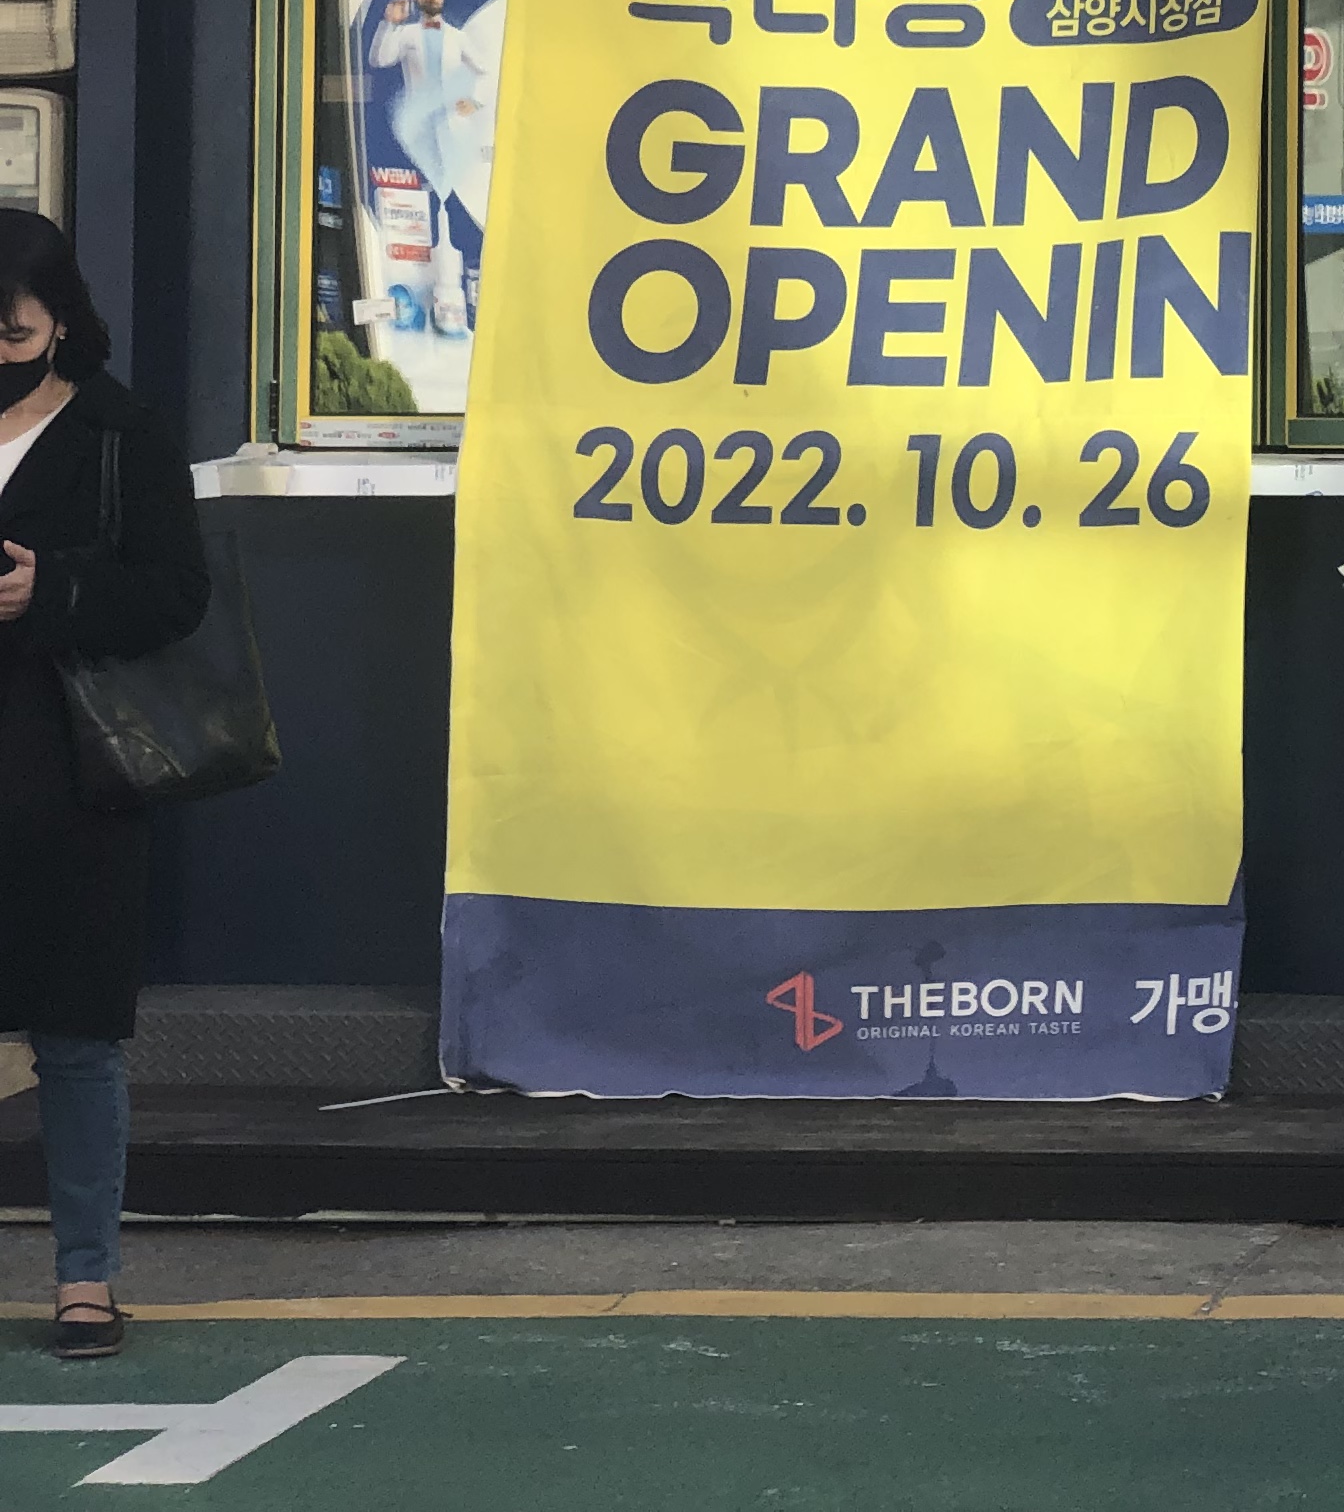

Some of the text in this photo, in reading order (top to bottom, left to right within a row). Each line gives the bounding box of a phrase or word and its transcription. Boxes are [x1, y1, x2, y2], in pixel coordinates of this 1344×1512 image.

[605, 75, 1230, 228] GRAND
[588, 232, 1252, 387] OPENIN
[573, 426, 1211, 529] 2022. 10. 26
[850, 979, 1084, 1018] THEBORN
[856, 1021, 1082, 1040] ORIGINAL KOREAN TASTE
[1130, 970, 1237, 1035] 가맹
